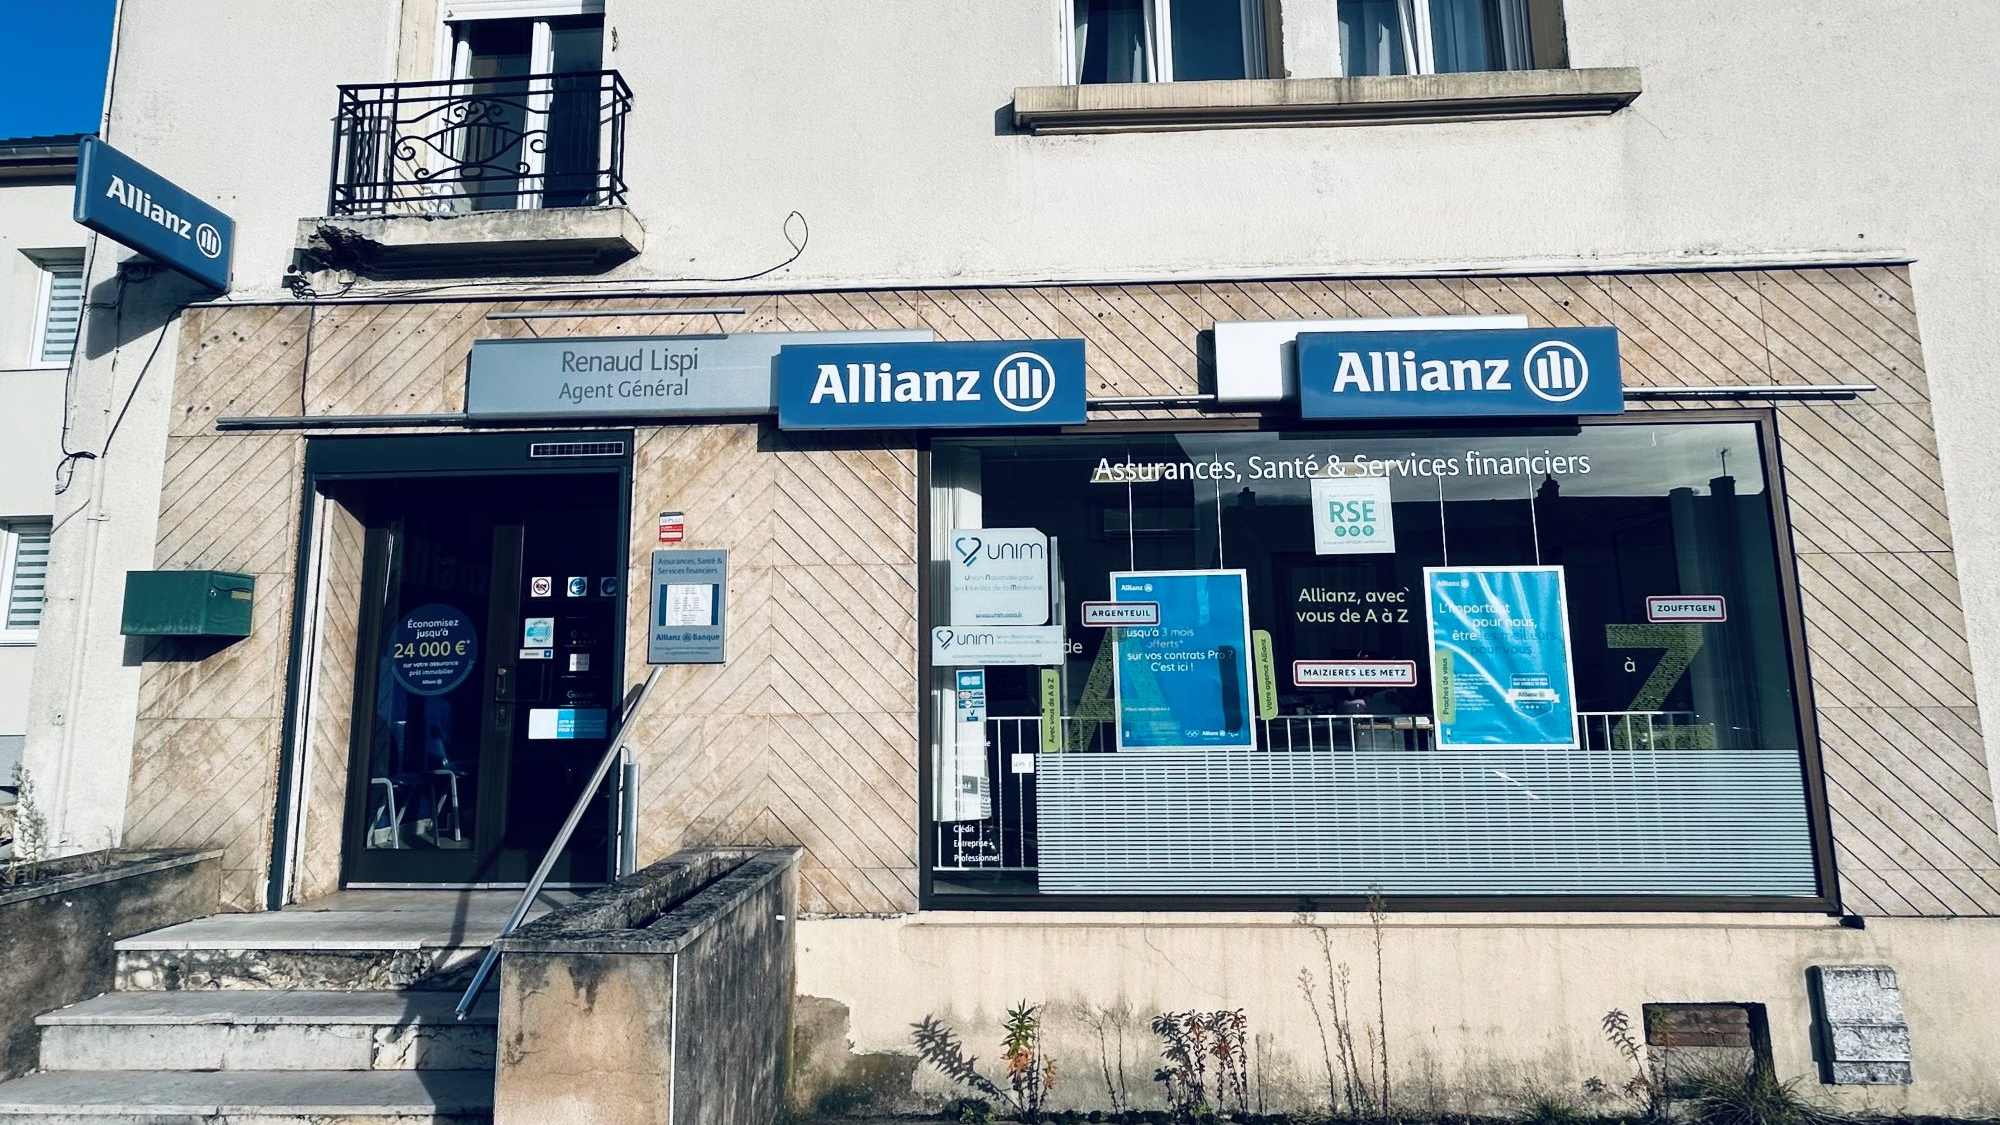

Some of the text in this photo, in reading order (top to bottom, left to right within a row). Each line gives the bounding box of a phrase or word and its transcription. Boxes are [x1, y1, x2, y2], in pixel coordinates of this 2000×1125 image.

[105, 174, 192, 240] Allianz
[562, 347, 699, 377] Renaud Lispi
[1333, 350, 1511, 393] Allianz
[810, 362, 981, 404] Allianz
[559, 379, 689, 404] Agent Général
[1095, 451, 1591, 484] Assurances, Santé & Services financiers
[1329, 500, 1377, 523] RSE
[1299, 588, 1405, 605] Allianz avec
[1092, 609, 1151, 617] ARGENTEUIL
[1297, 609, 1409, 623] vous de A à Z
[408, 618, 460, 629] Économisez
[1473, 619, 1503, 629] pour
[416, 628, 449, 640] jusqu'à
[1162, 628, 1168, 637] 3
[1171, 627, 1194, 637] mois
[1452, 630, 1477, 641] être
[693, 634, 720, 643] Banque
[394, 642, 415, 659] 24
[420, 641, 451, 657] 000
[1064, 639, 1083, 654] de
[1503, 646, 1533, 655] vous
[1127, 653, 1143, 661] sur
[1164, 651, 1206, 660] contrats
[1208, 650, 1226, 660] Pro
[1151, 662, 1176, 672] C'est
[1178, 662, 1189, 672] ici
[1624, 656, 1636, 673] à
[1304, 669, 1406, 677] MAIZIERES LES METZ
[1442, 676, 1448, 686] de
[1605, 623, 1718, 750] Z
[1049, 698, 1054, 707] de
[953, 825, 975, 833] Cédit
[954, 840, 989, 849] Etreprise
[954, 854, 1000, 862] Pofessionnel
